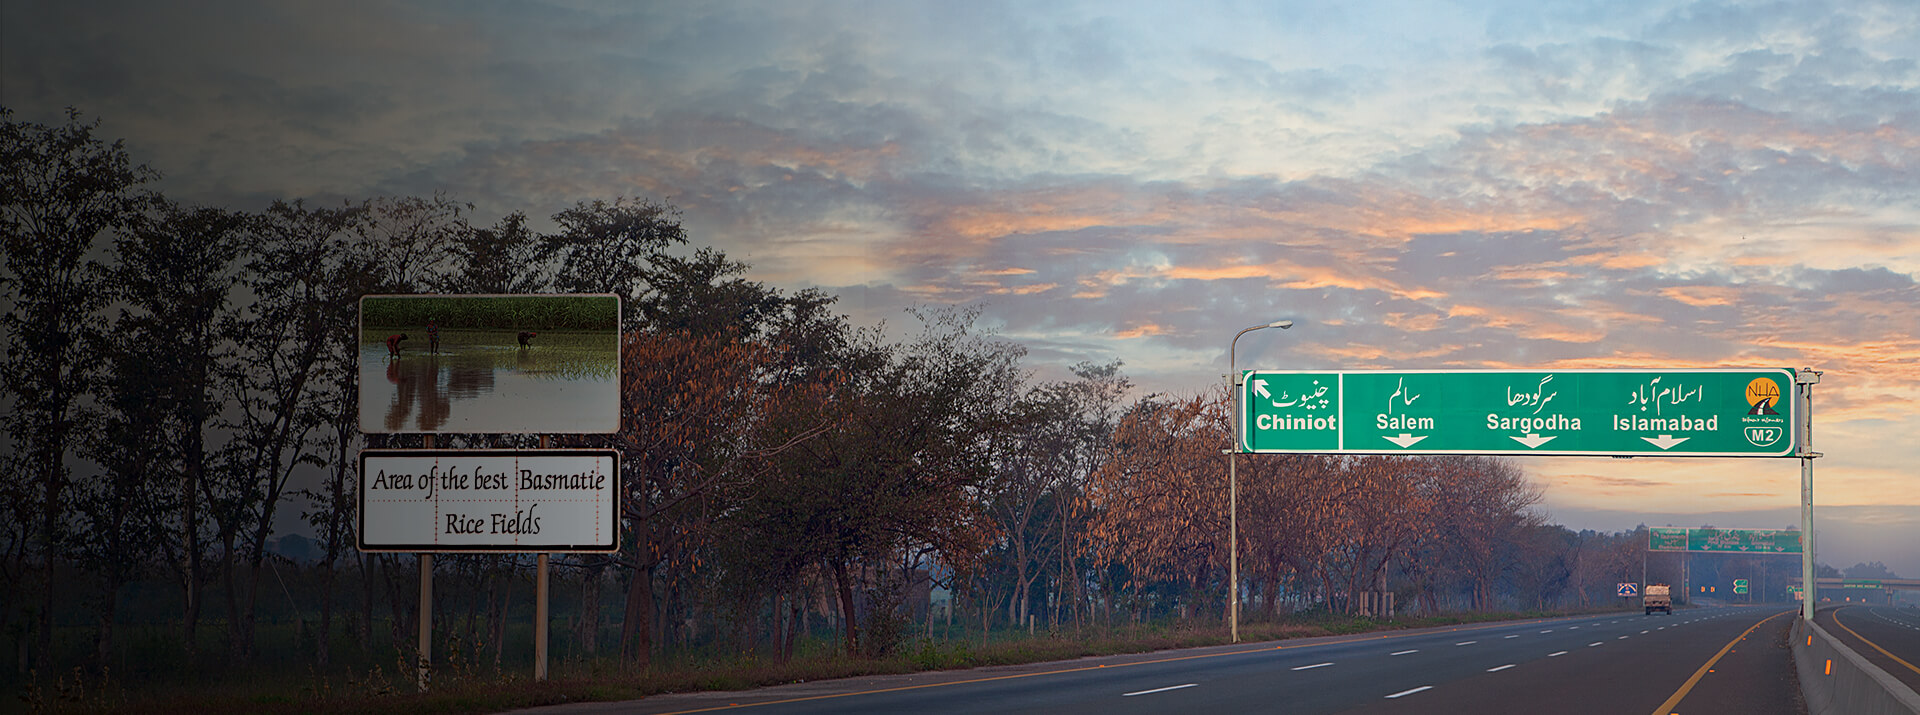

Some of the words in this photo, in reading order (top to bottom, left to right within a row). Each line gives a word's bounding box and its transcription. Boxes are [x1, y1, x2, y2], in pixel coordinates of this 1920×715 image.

[1388, 377, 1420, 414] سالم
[1507, 374, 1557, 414] سرگودھا
[1256, 414, 1336, 430] Chiniot
[1376, 413, 1434, 430] Salem
[1486, 413, 1581, 434] Sargodha
[1613, 414, 1718, 431] Islamabad
[1752, 429, 1774, 442] M2
[372, 468, 413, 490] Area
[418, 465, 438, 499] of
[442, 466, 470, 490] the
[474, 466, 508, 490] best
[520, 469, 605, 490] Basmatie
[445, 513, 484, 534] Rice
[490, 504, 541, 535] Fields
